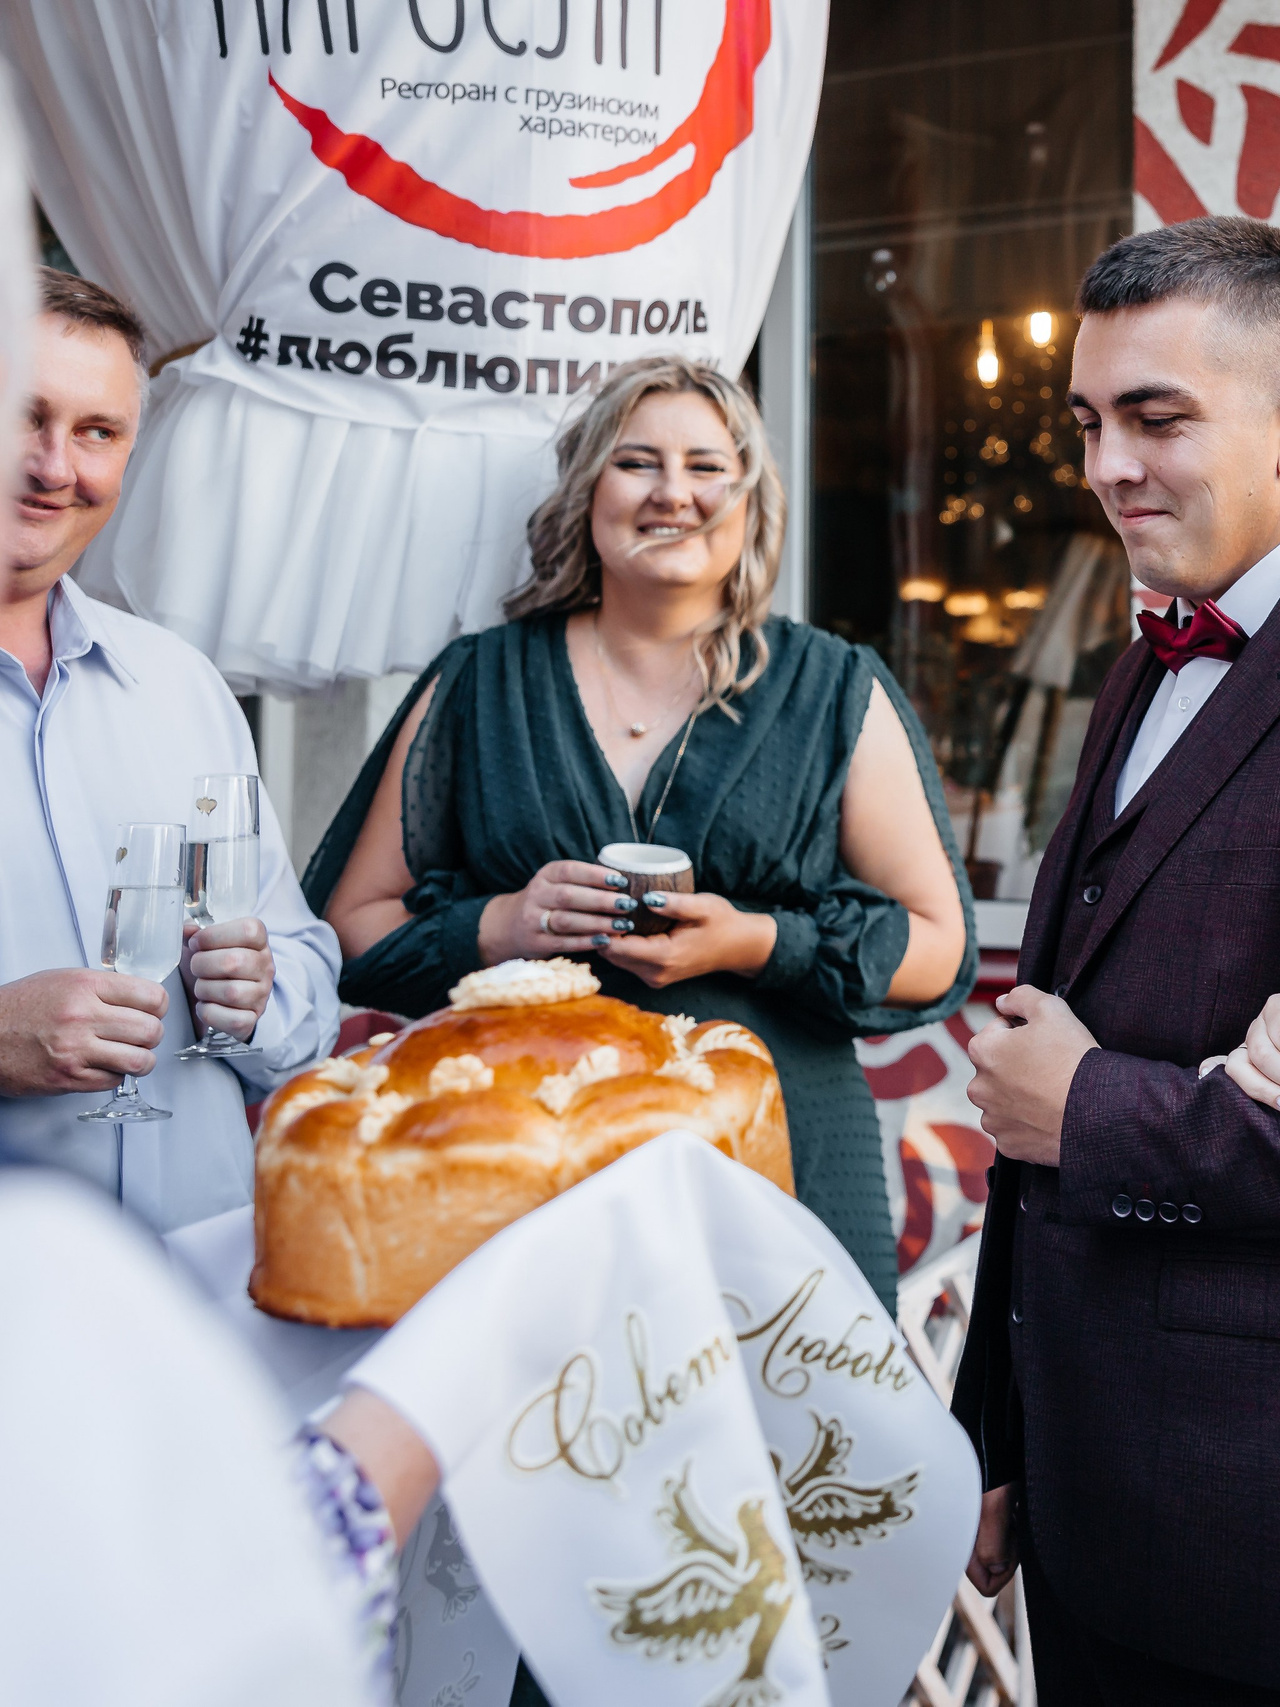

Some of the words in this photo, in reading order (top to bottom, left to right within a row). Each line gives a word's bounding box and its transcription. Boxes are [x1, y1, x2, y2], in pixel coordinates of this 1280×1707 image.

[381, 78, 497, 105] Ресторан
[504, 86, 518, 104] с
[525, 88, 660, 120] грузинским
[518, 115, 658, 147] характером
[309, 262, 708, 335] Севастополь
